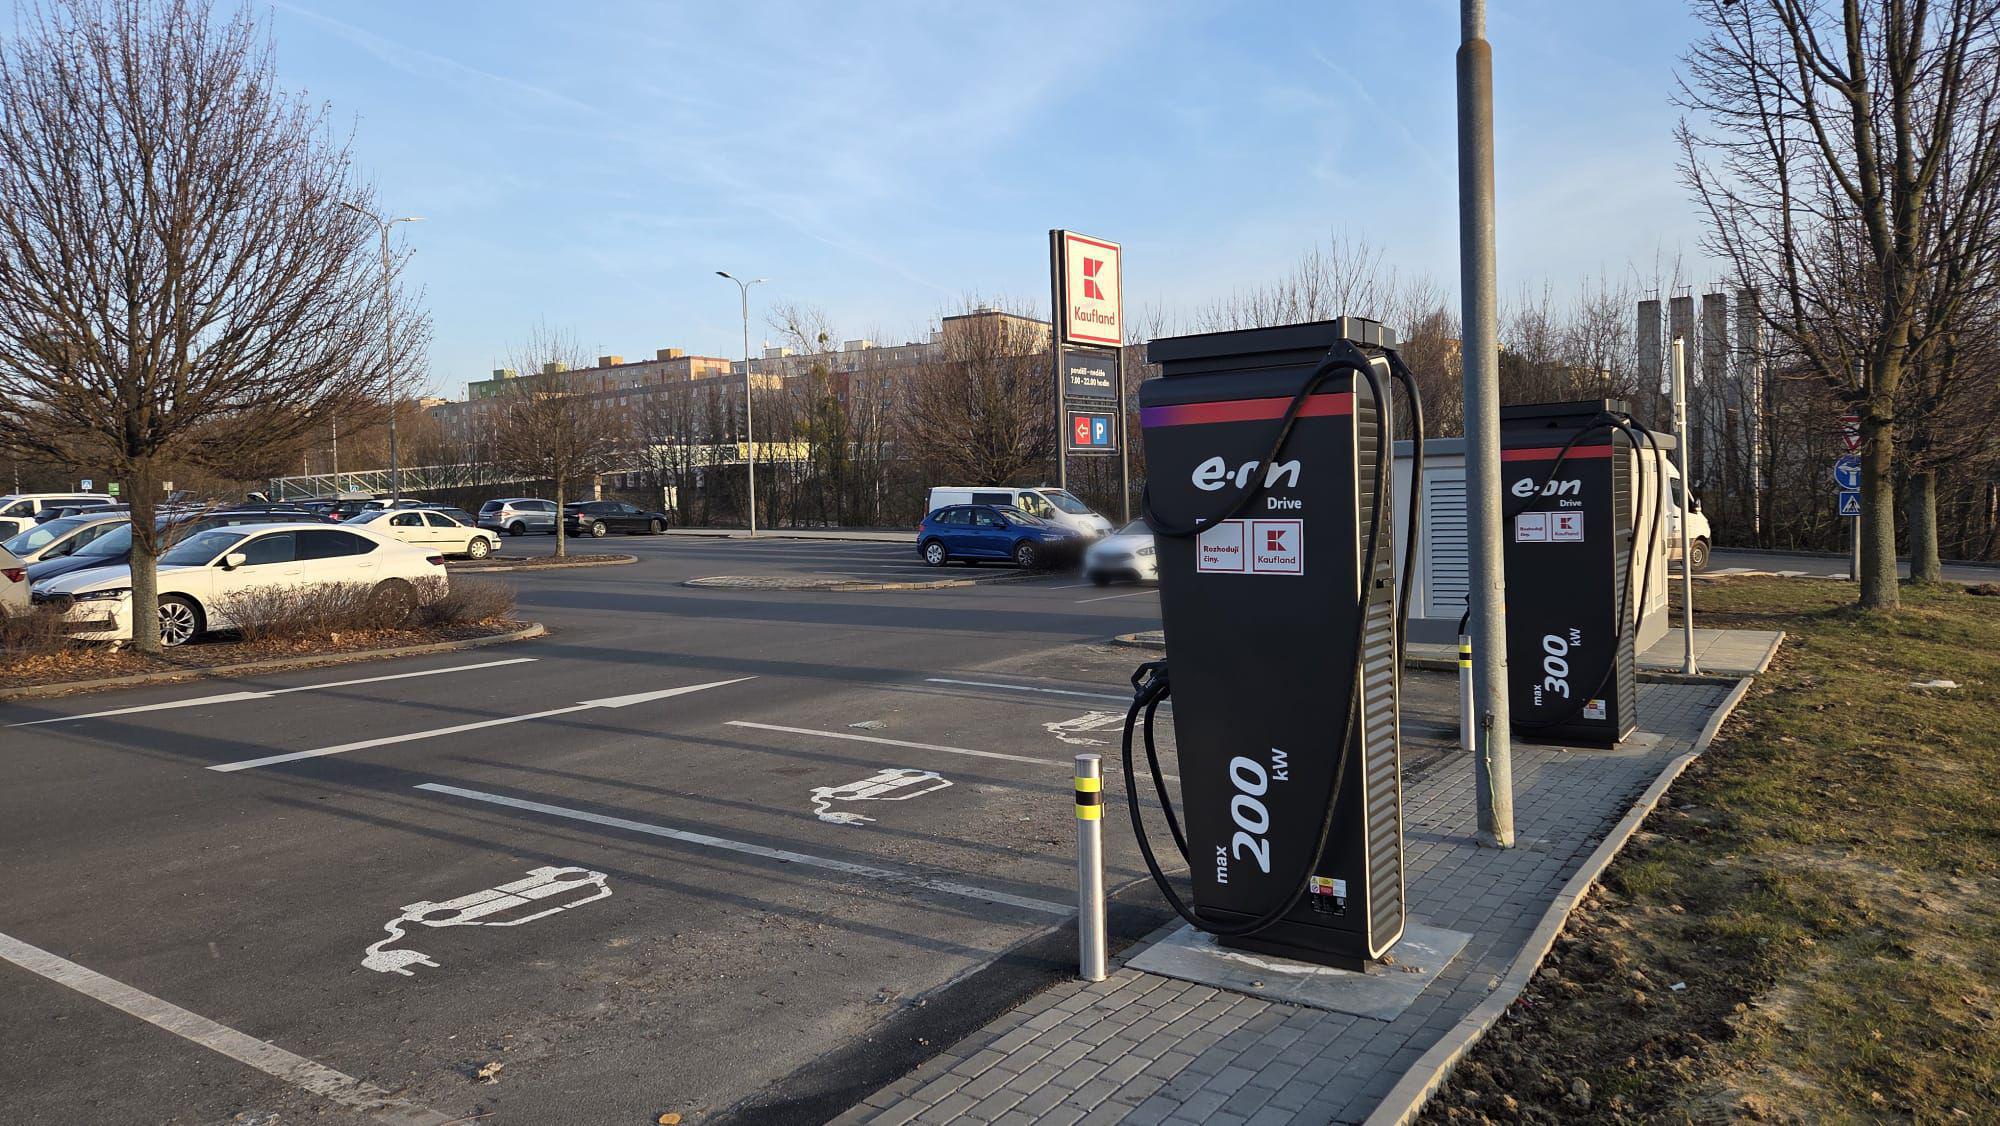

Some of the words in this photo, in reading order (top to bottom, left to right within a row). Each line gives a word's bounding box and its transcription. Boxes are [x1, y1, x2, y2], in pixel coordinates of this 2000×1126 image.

[1074, 306, 1115, 326] Kaufland
[1095, 423, 1104, 439] P
[1267, 497, 1302, 509] Drive
[1560, 499, 1582, 507] Drive
[1203, 545, 1239, 554] Rozhodují
[1257, 555, 1296, 564] Kaufland
[1533, 684, 1542, 706] max
[1542, 634, 1570, 699] 300
[1569, 628, 1581, 646] kW
[1216, 845, 1228, 884] max
[1229, 756, 1271, 874] 200
[1271, 748, 1289, 781] kW
